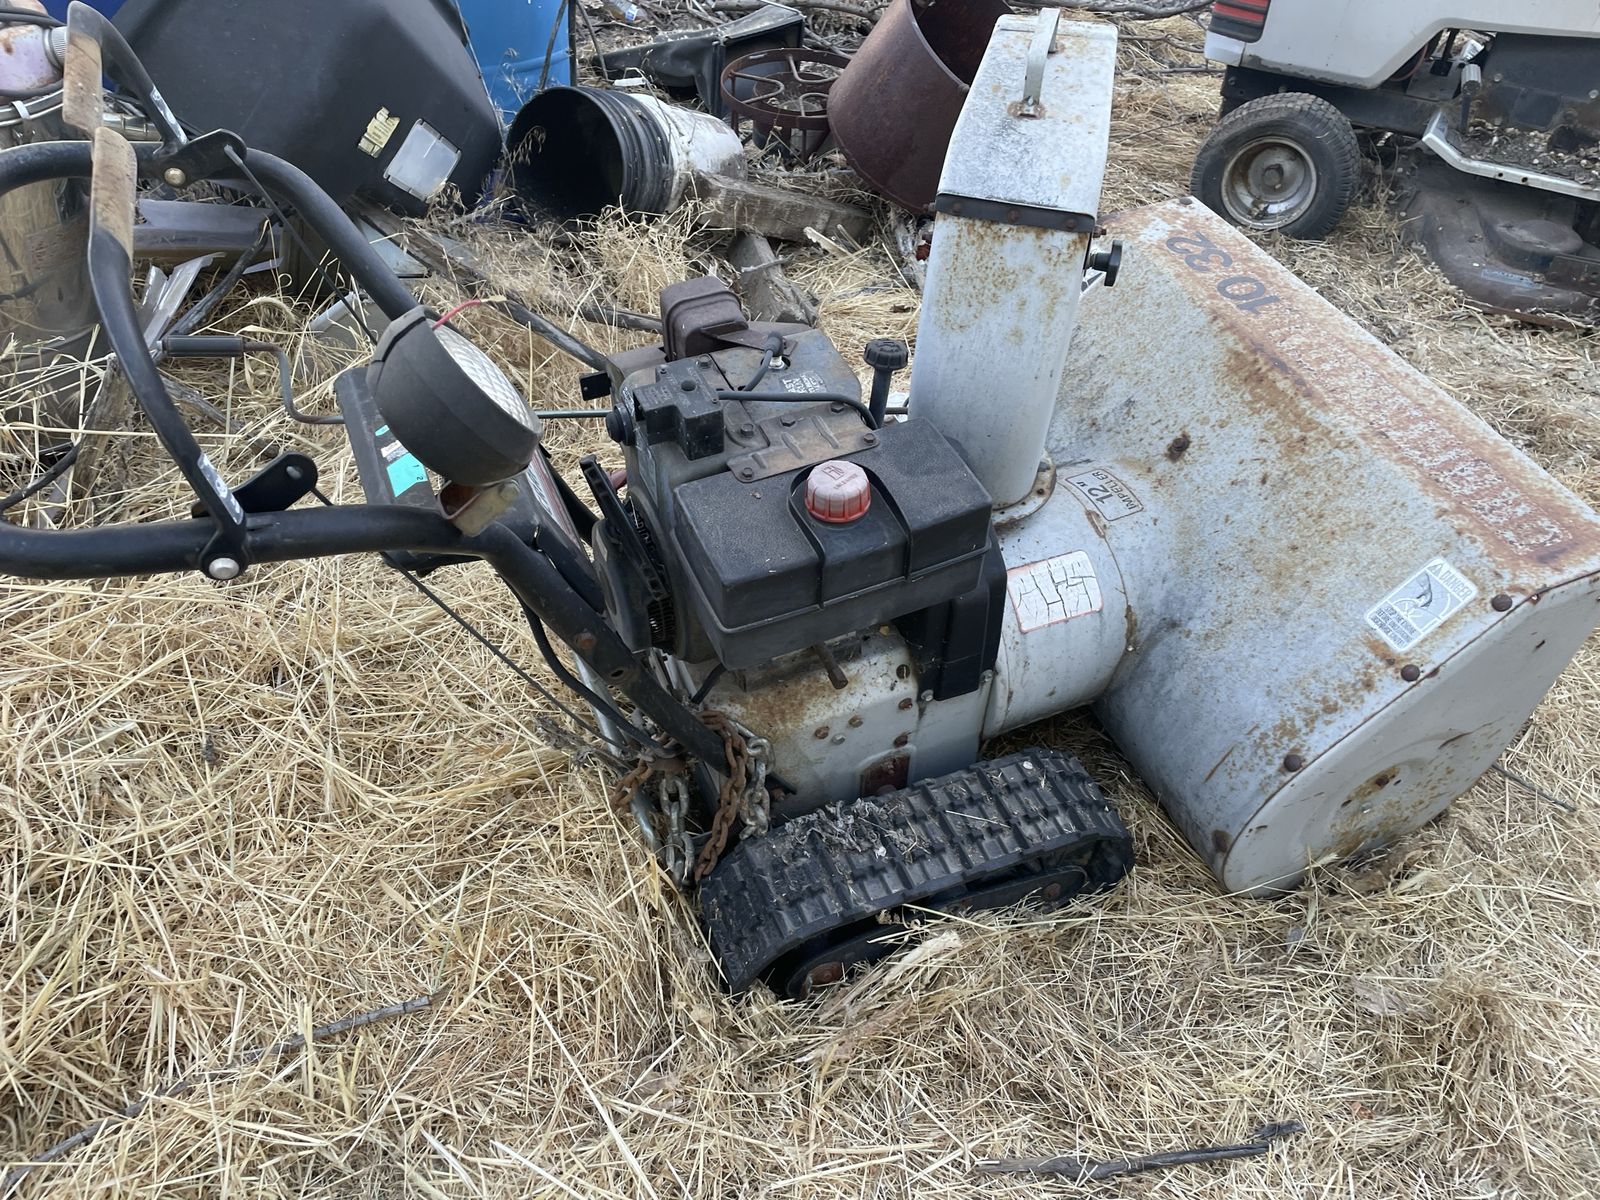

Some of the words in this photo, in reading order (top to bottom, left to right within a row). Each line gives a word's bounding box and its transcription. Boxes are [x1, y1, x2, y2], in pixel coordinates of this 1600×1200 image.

[1166, 231, 1233, 273] 32
[1216, 276, 1280, 317] 10
[1092, 471, 1137, 510] IMPELLER
[1439, 569, 1472, 601] DANGER
